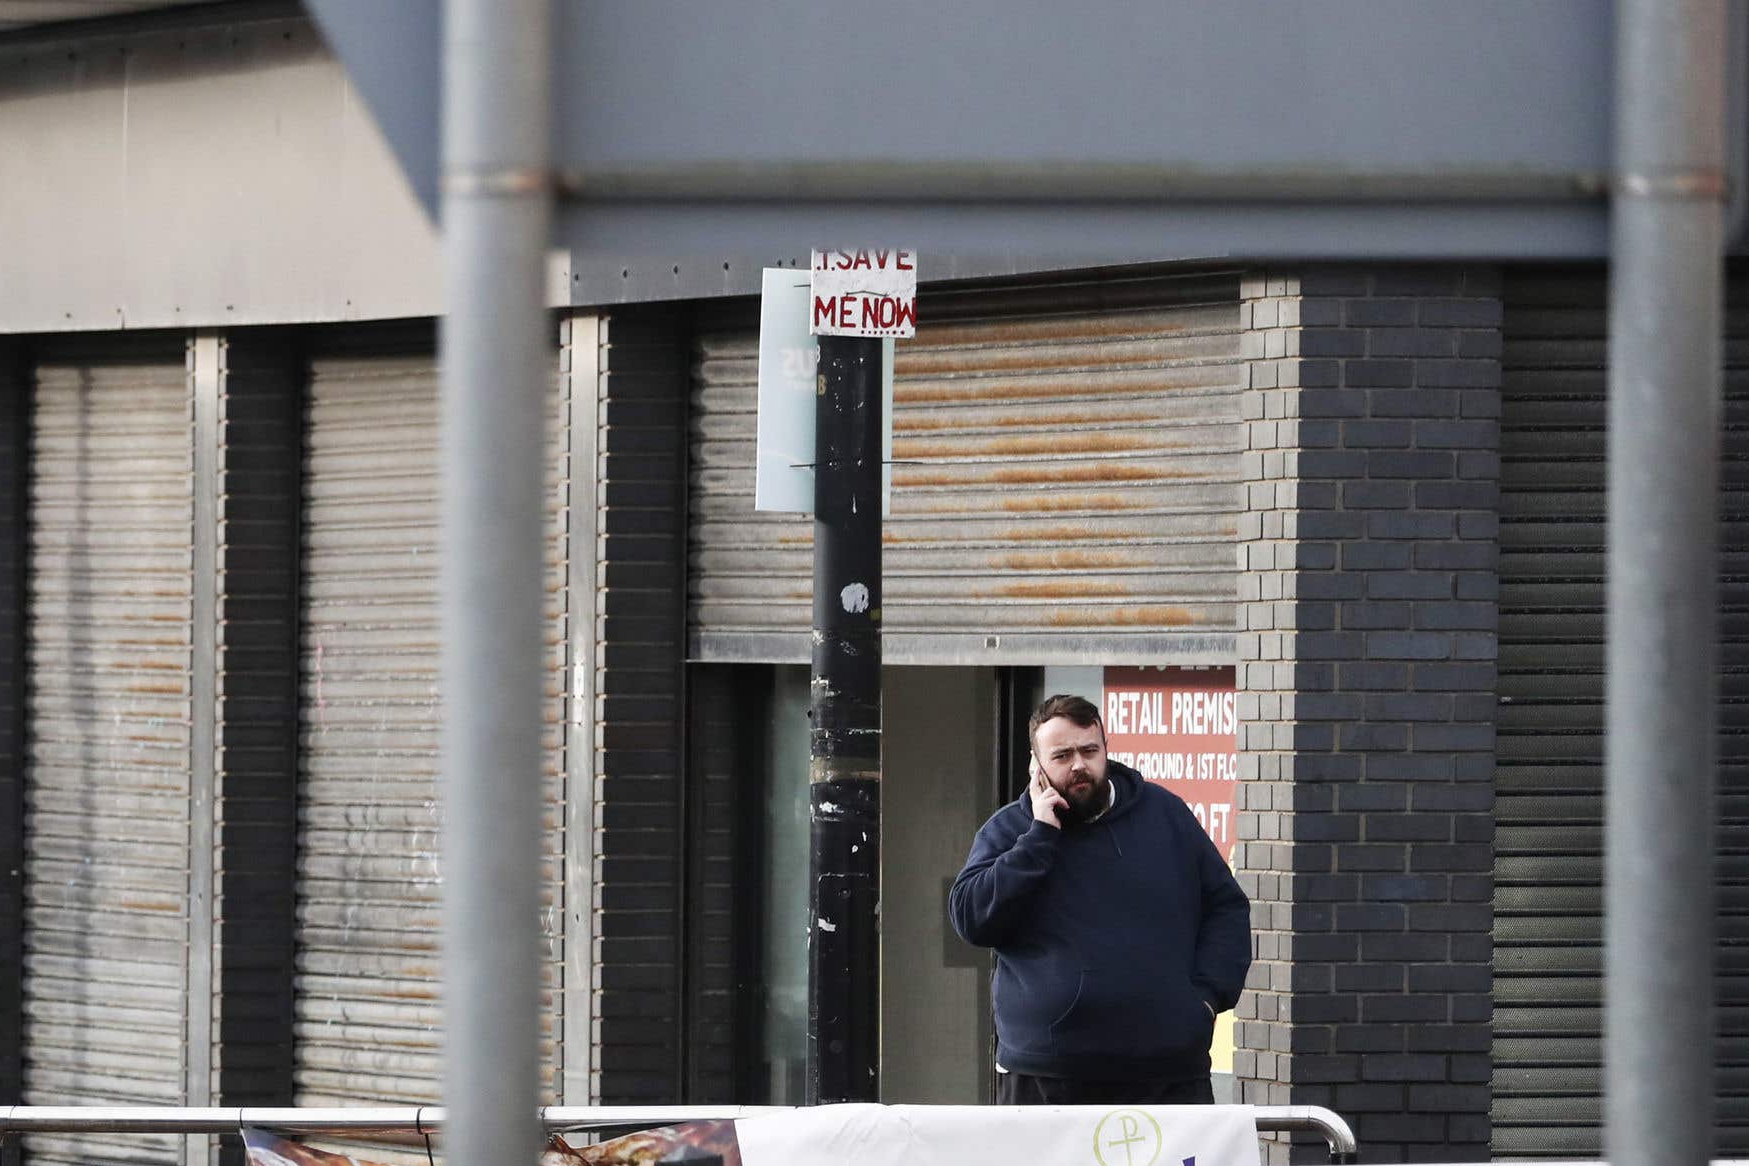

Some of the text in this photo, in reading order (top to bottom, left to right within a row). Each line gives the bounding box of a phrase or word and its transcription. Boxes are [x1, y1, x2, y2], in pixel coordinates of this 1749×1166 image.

[814, 295, 917, 329] ME NOW
[1107, 691, 1168, 735] RETAIL
[1136, 752, 1184, 780] GROUND
[1186, 753, 1194, 780] &
[1209, 802, 1231, 843] FT
